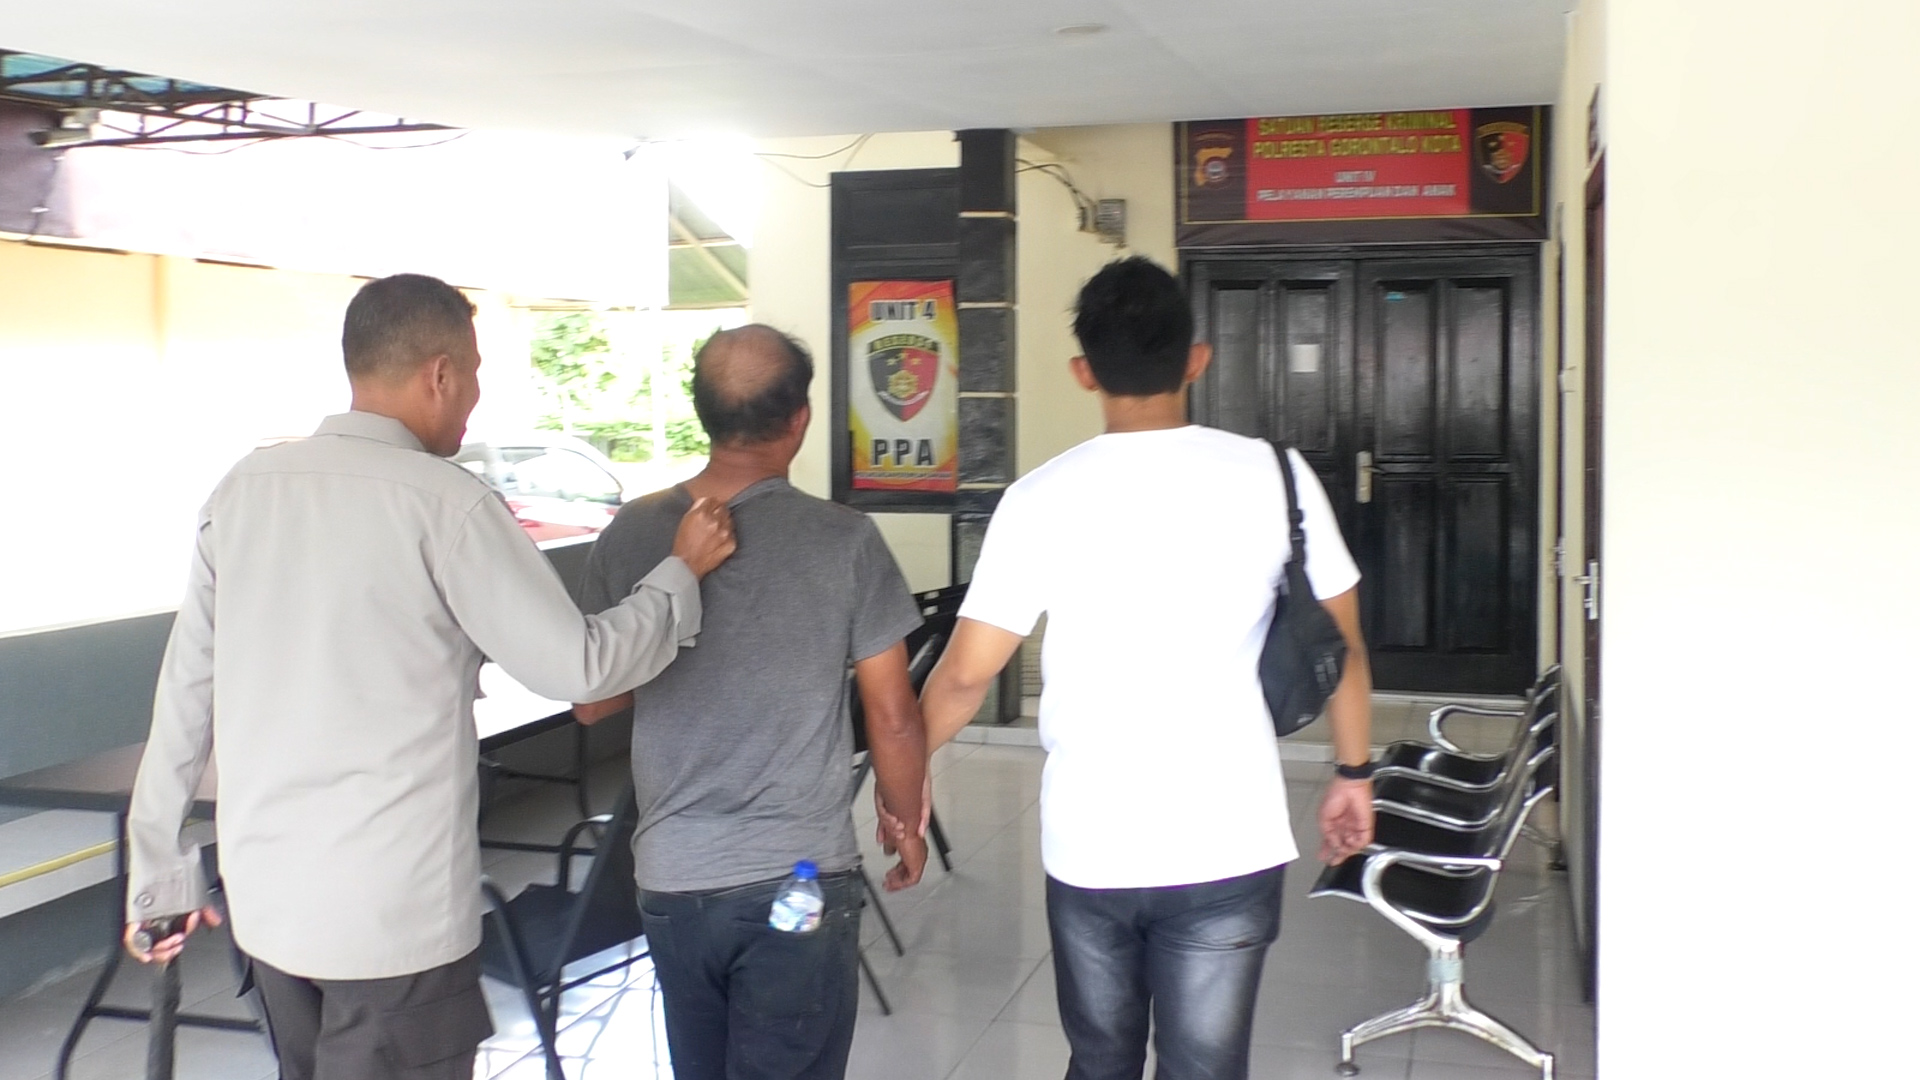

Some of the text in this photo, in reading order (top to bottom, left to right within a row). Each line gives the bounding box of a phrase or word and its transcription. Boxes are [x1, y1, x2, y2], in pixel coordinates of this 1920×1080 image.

[1253, 135, 1461, 159] POLRESTA GORONTALO KOTA
[869, 299, 937, 322] UNIT 4
[871, 438, 936, 468] PPA
